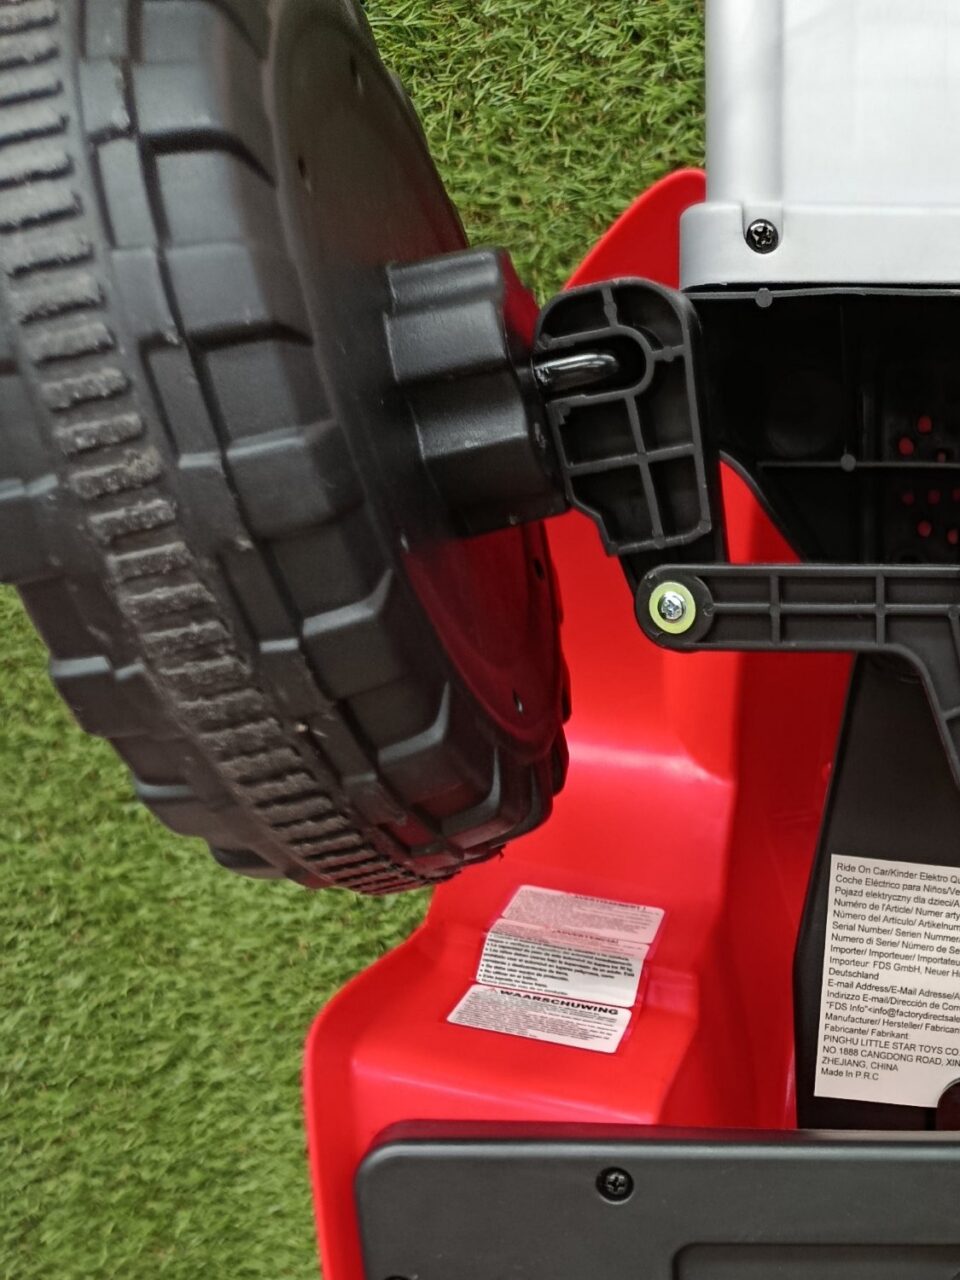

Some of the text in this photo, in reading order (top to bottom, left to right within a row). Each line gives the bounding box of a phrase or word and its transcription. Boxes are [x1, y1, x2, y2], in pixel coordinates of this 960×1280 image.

[836, 862, 856, 873] Ride
[858, 864, 871, 874] On
[873, 866, 918, 879] Car/Kinder
[919, 871, 949, 883] Elektro
[835, 874, 863, 885] Coche
[902, 883, 921, 892] para
[834, 885, 864, 898] Pojazd
[865, 890, 912, 904] elektryczny
[913, 895, 926, 904] dla
[868, 902, 880, 911] de
[915, 907, 944, 918] Numer
[868, 913, 881, 923] del
[832, 920, 856, 932] Serial
[857, 924, 894, 936] Number/
[894, 928, 922, 939] Serien
[830, 944, 868, 956] Importer/
[831, 932, 865, 944] Numero
[865, 937, 874, 945] di
[875, 937, 901, 948] Serie/
[935, 945, 947, 954] de
[828, 967, 880, 981] Deutschland
[872, 960, 892, 971] FDS
[924, 966, 950, 977] Neuer
[827, 978, 854, 989] E-mail
[855, 981, 917, 996] Address/E-Mail
[500, 990, 619, 1016] WAARSCHUWING
[826, 989, 861, 1001] Indirizzo
[929, 1001, 940, 1010] de
[824, 1012, 881, 1026] Manufacturer/
[882, 1018, 924, 1030] Hersteller/
[824, 1023, 870, 1036] Fabricante/
[823, 1034, 859, 1046] PINGHU
[860, 1038, 891, 1049] LITTLE
[891, 1041, 917, 1052] STAR
[918, 1044, 943, 1055] TOYS
[860, 1049, 914, 1063] CANGDONG
[820, 1067, 844, 1077] Made
[845, 1070, 853, 1078] In
[870, 1061, 899, 1072] CHINA
